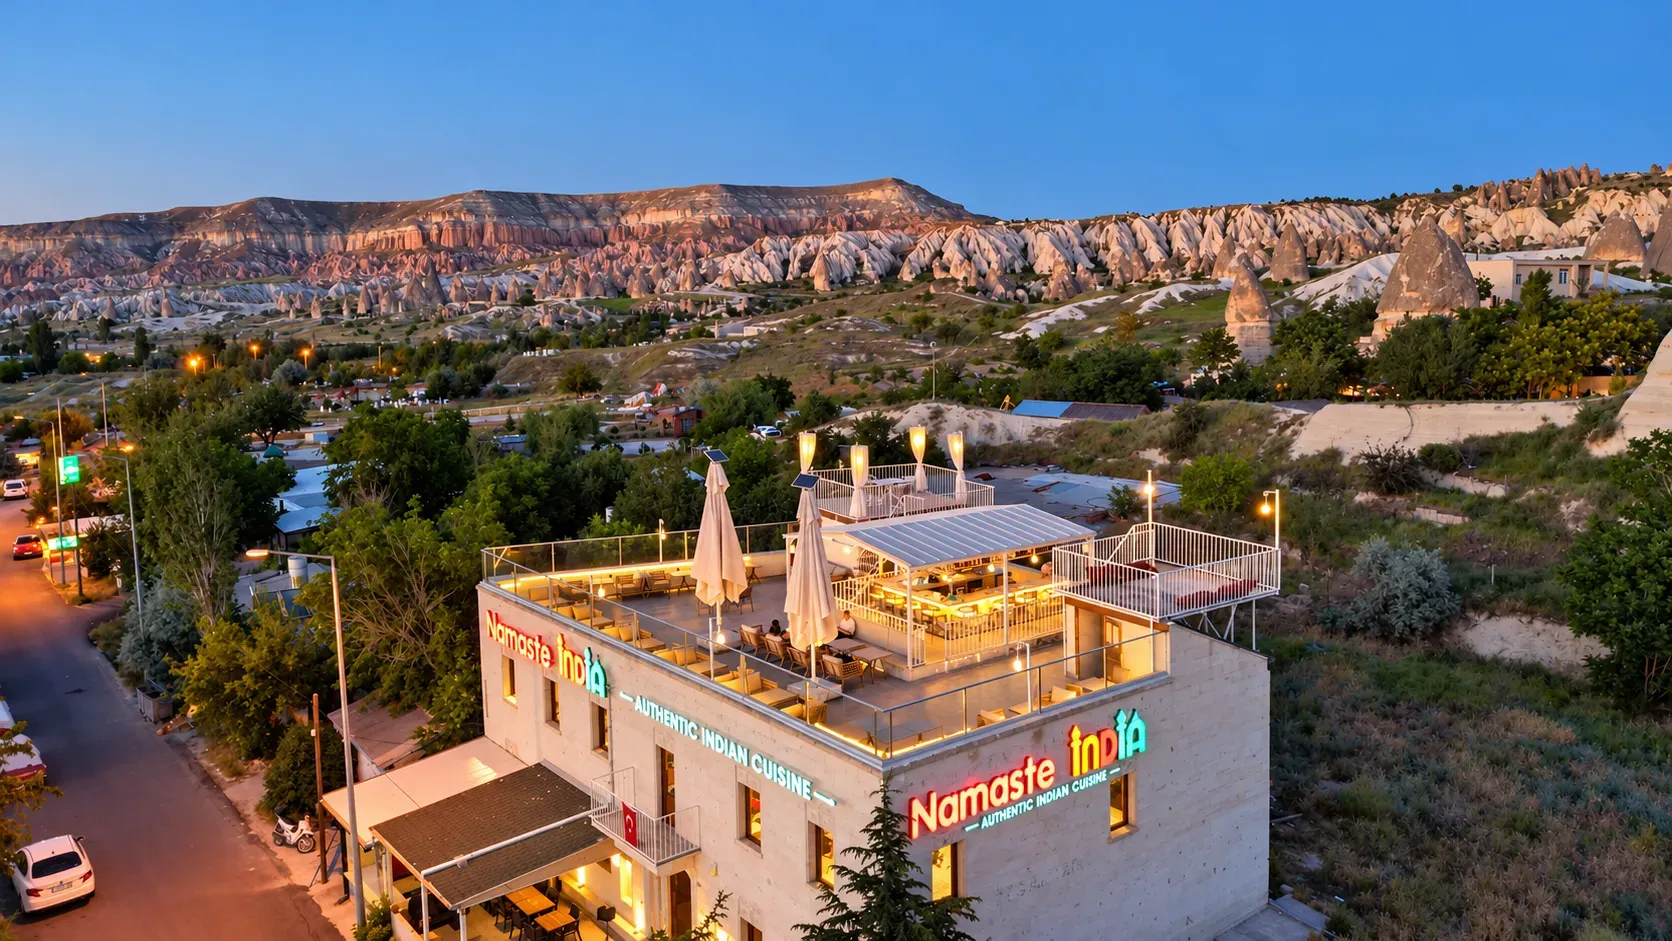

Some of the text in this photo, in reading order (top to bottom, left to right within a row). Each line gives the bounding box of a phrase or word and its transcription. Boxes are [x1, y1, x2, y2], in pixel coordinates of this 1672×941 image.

[486, 610, 554, 668] Namaste
[635, 695, 813, 800] AUTHENTIC INDIAN CUISINE
[908, 755, 1055, 840] Namaste
[981, 769, 1107, 829] AUTHENTIC INDIAN CUISINE
